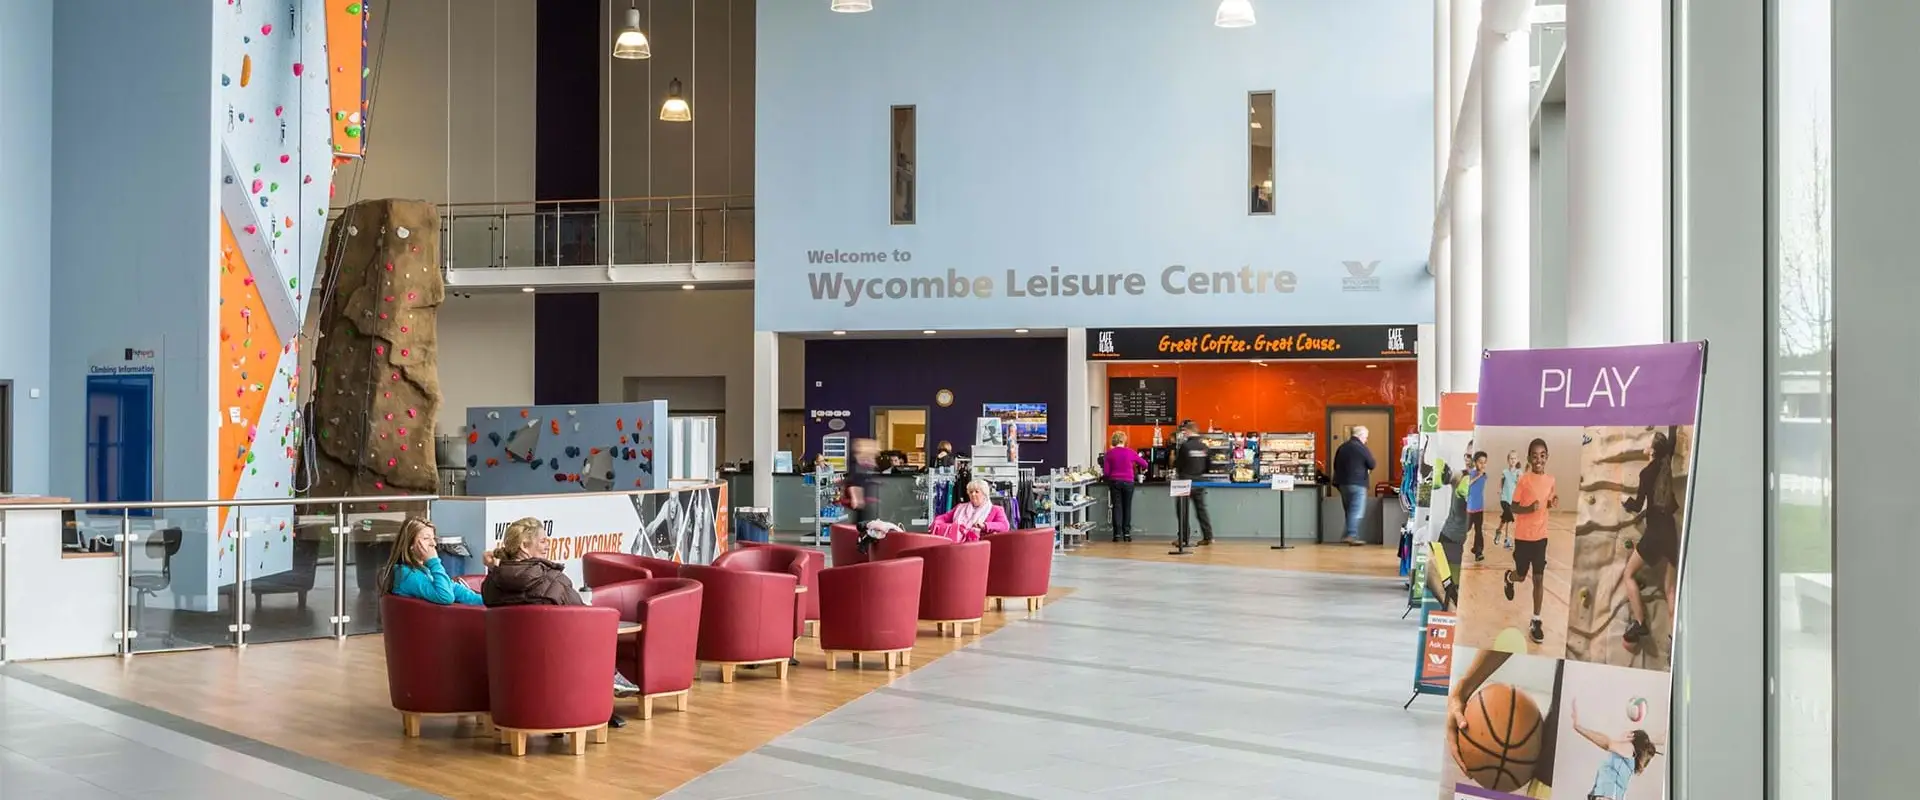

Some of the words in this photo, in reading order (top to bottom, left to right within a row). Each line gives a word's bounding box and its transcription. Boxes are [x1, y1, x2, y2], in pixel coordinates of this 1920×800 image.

[807, 249, 887, 264] Welcome
[892, 249, 912, 262] to
[807, 268, 994, 307] Wycombe
[1006, 266, 1146, 297] Leisure
[1161, 264, 1298, 294] Centre
[1158, 334, 1198, 353] Great
[1200, 333, 1252, 354] Coffee.
[1254, 333, 1293, 352] Great
[1296, 332, 1341, 352] Cause.
[90, 365, 117, 375] Climbing
[119, 364, 155, 373] Information
[1540, 366, 1640, 408] PLAY
[574, 533, 623, 559] WYCOMBE
[1429, 641, 1442, 649] Ask
